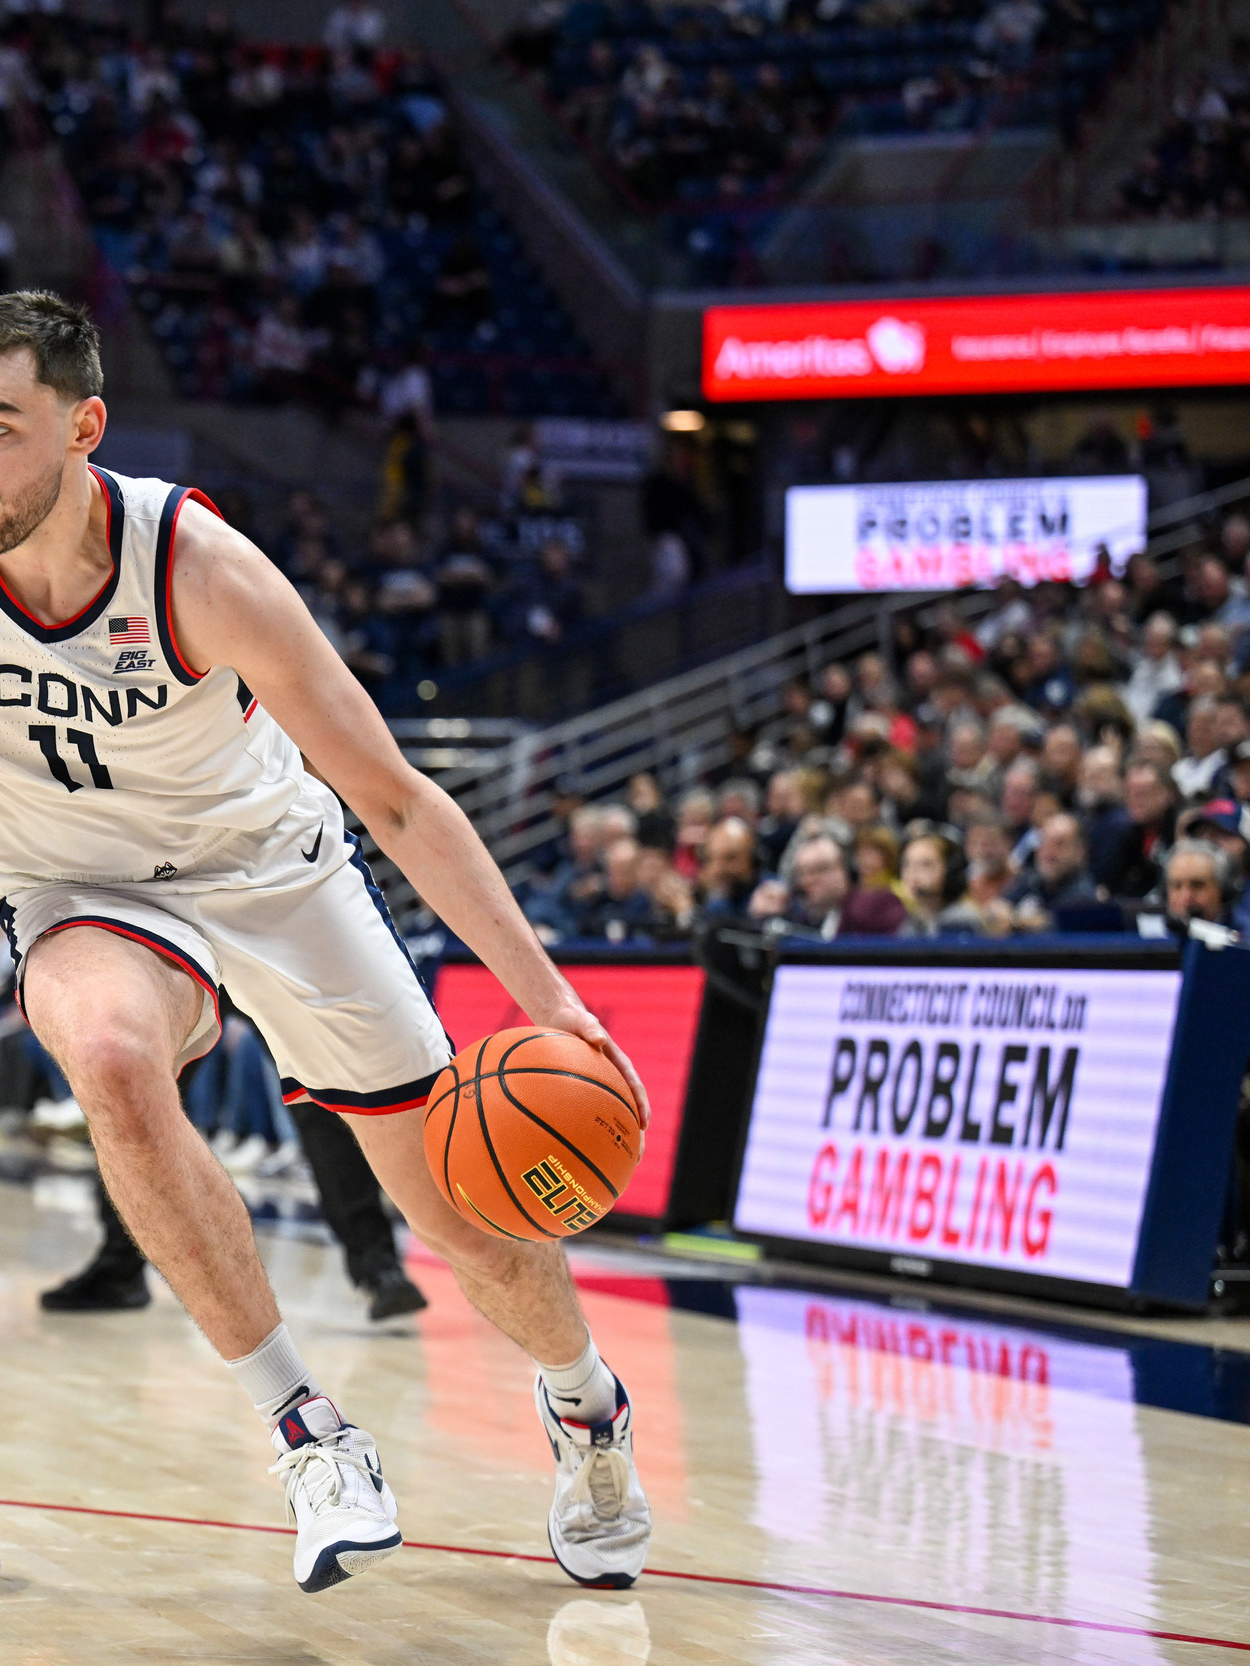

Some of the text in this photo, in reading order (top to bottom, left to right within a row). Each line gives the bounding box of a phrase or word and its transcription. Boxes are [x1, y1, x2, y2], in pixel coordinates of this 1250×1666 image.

[114, 660, 156, 670] EAST
[118, 651, 148, 660] BIG
[28, 725, 114, 793] 11
[840, 983, 968, 1024] CONNECTICUT
[971, 984, 1058, 1029] COUNCIL
[821, 1038, 1079, 1152] PROBLEM
[521, 1159, 599, 1232] ELITE
[807, 1141, 1058, 1258] GAMBLING
